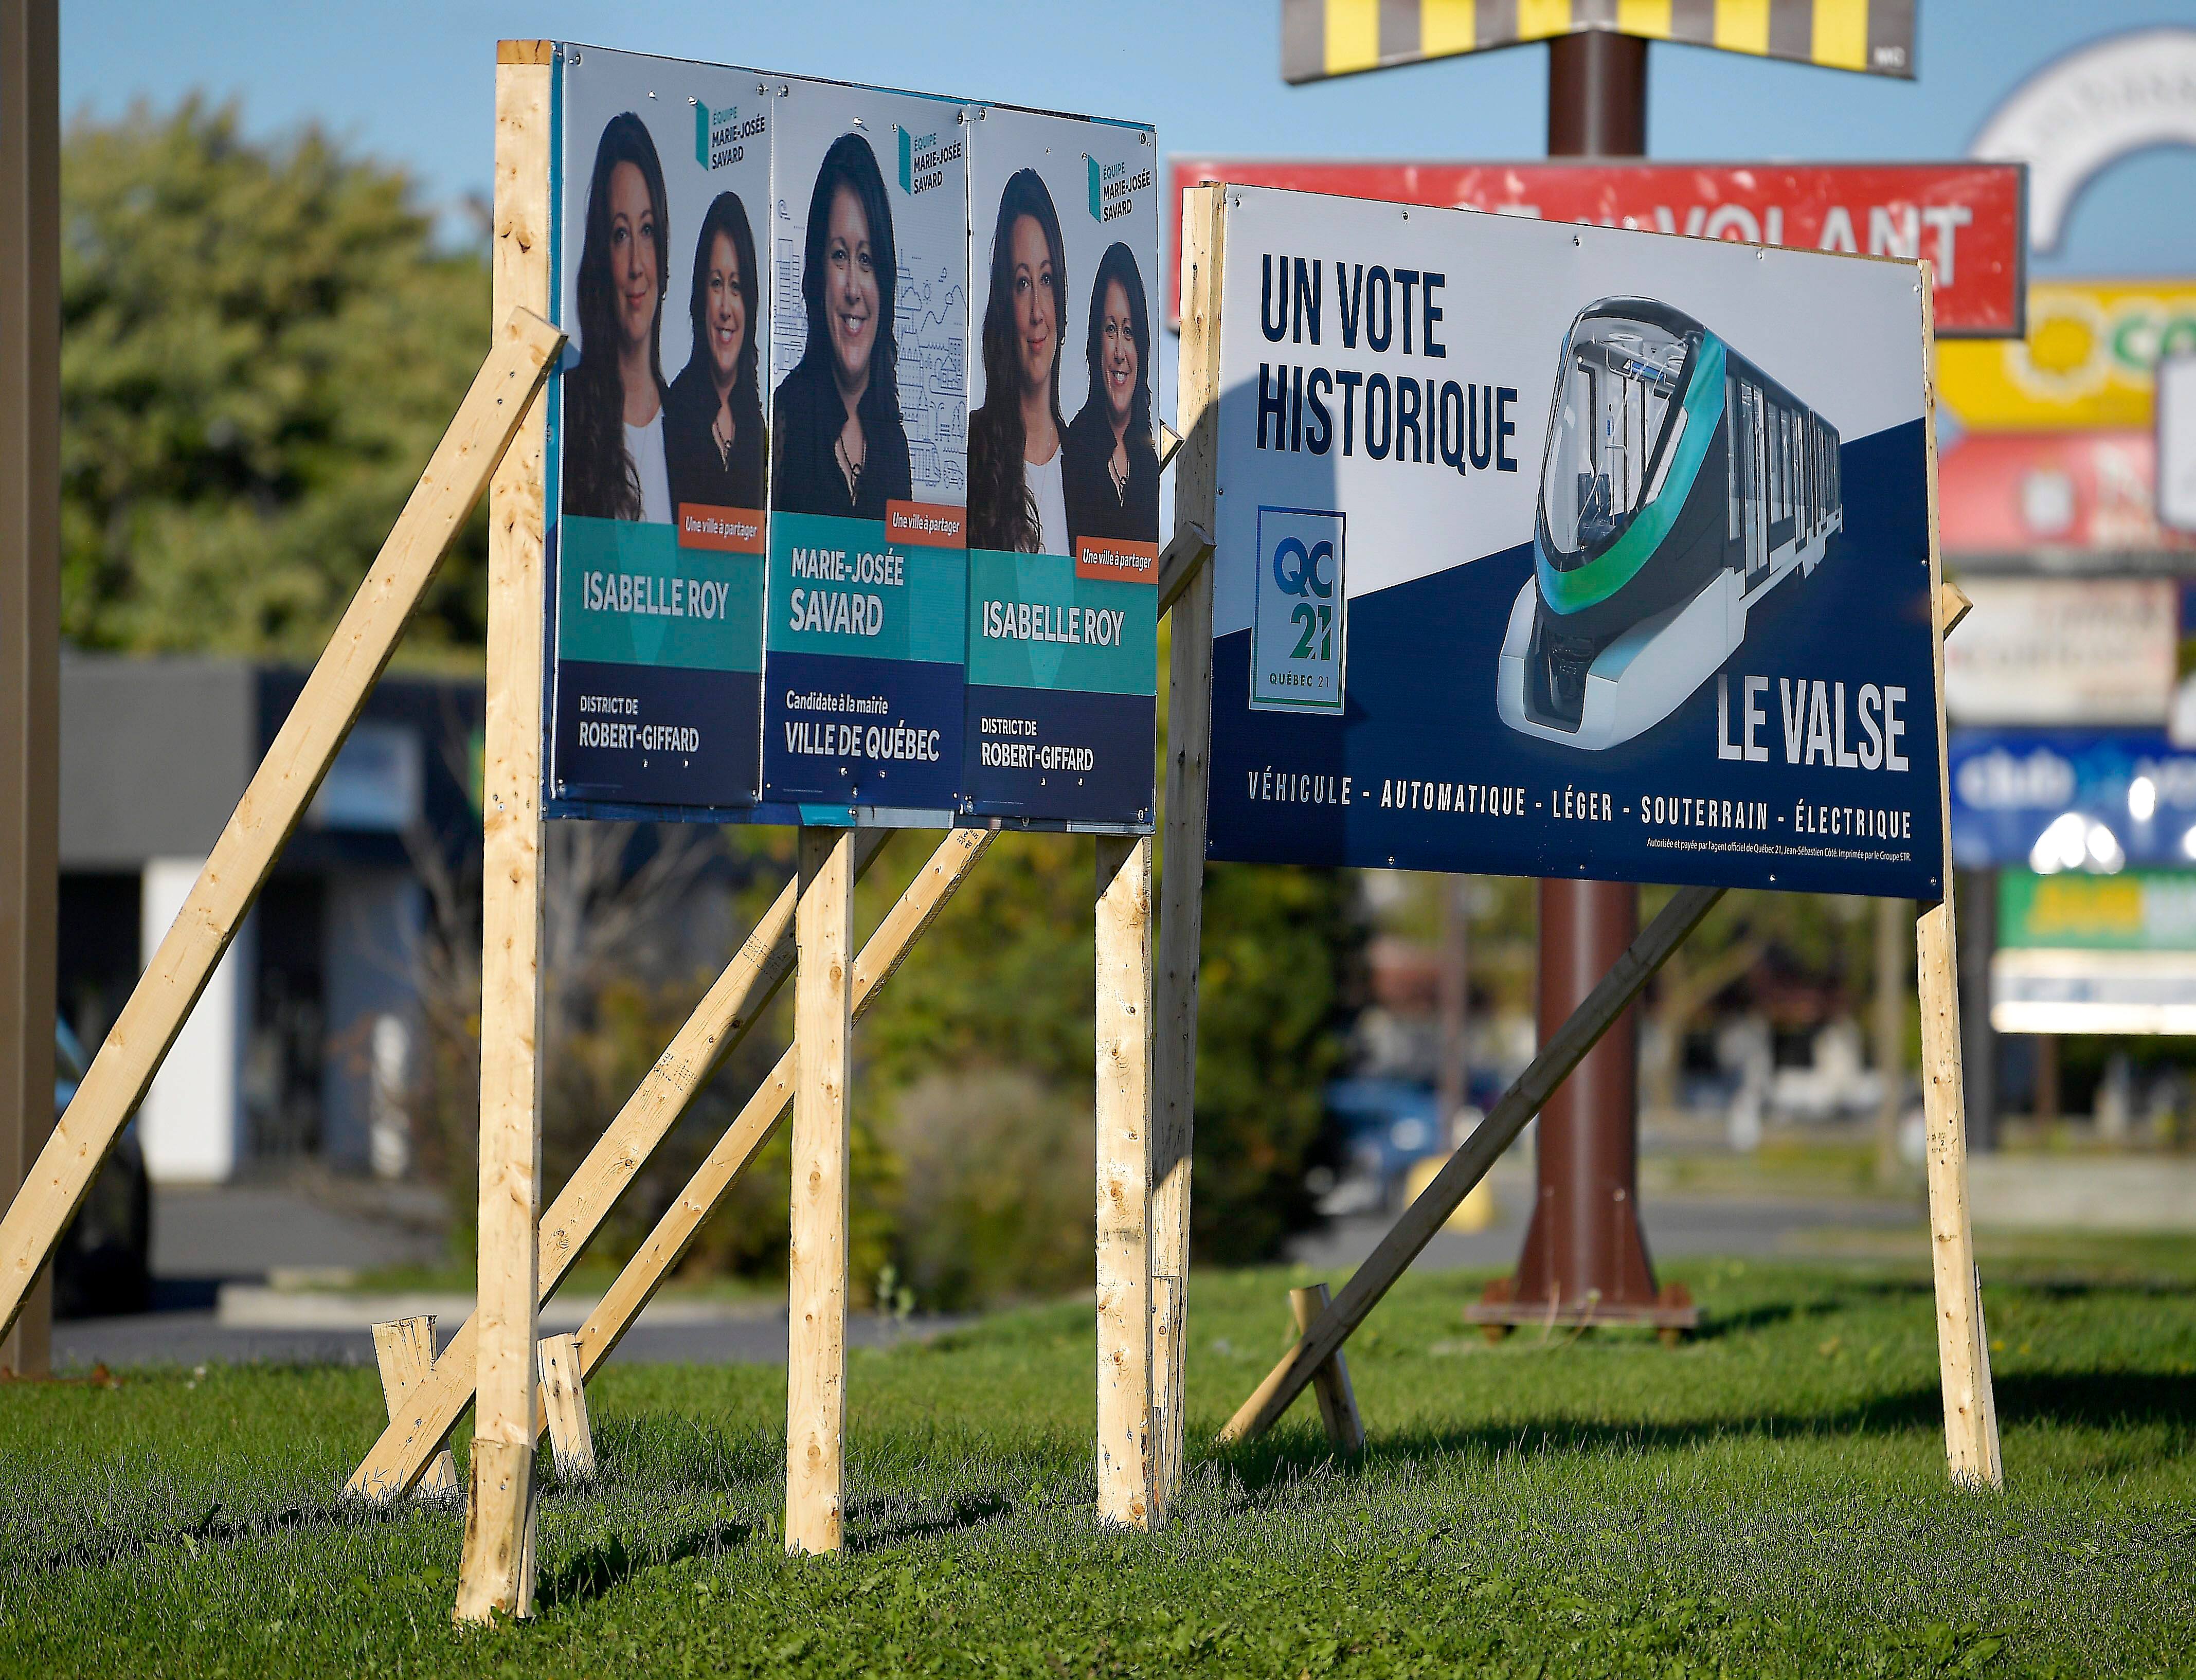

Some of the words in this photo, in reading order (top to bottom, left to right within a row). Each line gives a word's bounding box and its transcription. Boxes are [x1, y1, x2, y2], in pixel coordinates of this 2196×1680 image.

[712, 113, 765, 148] MARIE-JOSÉE
[712, 146, 743, 169] SAVARD
[914, 139, 961, 173] MARIE-JOSÉE
[1103, 161, 1124, 180] ÉQUIPE
[914, 171, 943, 194] SAVARD
[1103, 168, 1150, 201] MARIE-JOSÉE
[1104, 198, 1132, 222] SAVARD
[1262, 254, 1321, 346] UN
[1336, 261, 1446, 358] VOTE
[1257, 363, 1518, 476] HISTORIQUE
[892, 512, 907, 528] Une
[909, 514, 924, 530] ville
[924, 515, 929, 530] à
[929, 518, 960, 536] partager
[791, 547, 904, 585] MARIE-JOSÉE
[1083, 548, 1097, 564] Une
[1099, 550, 1113, 565] ville
[1114, 550, 1119, 566] à
[1119, 553, 1151, 572] partager
[1273, 536, 1333, 598] QC
[584, 571, 683, 616] ISABELLE
[688, 579, 729, 619] ROY
[789, 588, 884, 636] SAVARD
[983, 601, 1080, 643] ISABELLE
[1084, 608, 1125, 646] ROY
[1289, 602, 1331, 660] 21
[1270, 671, 1312, 687] QUÉBEC
[1318, 676, 1329, 687] 21
[580, 695, 624, 713] DISTRICT
[625, 698, 638, 715] DE
[786, 690, 837, 711] Candidate
[839, 693, 844, 711] à
[847, 694, 855, 712] la
[856, 696, 888, 714] mairie
[580, 721, 700, 752] ROBERT-GIFFARD
[981, 718, 1023, 735] DISTRICT
[1025, 720, 1037, 735] DE
[1718, 674, 1768, 762] LE
[1779, 677, 1909, 772] VALSE
[785, 721, 835, 755] VILLE
[839, 725, 863, 756] DE
[866, 719, 940, 761] QUÉBEC
[982, 742, 1093, 771] ROBERT-GIFFARD
[1248, 766, 1352, 805] VÉHICULE
[1381, 780, 1524, 816] AUTOMATIQUE
[1552, 785, 1612, 821] LÉGER
[1642, 796, 1768, 830] SOUTERRAIN
[1795, 799, 1911, 839] ÉLECTRIQUE
[1647, 838, 1673, 847] Autorisée
[1681, 840, 1697, 851] payée
[1699, 842, 1707, 851] par
[1708, 841, 1726, 852] l'agent
[1727, 842, 1745, 852] officiel
[1746, 844, 1753, 852] de
[1754, 844, 1774, 854] Québec
[1784, 846, 1823, 856] Jean-Sébastien
[1839, 849, 1864, 859] Imprimée
[1865, 852, 1874, 861] par
[1880, 851, 1899, 862] Groupe
[1900, 853, 1911, 861] ETR.
